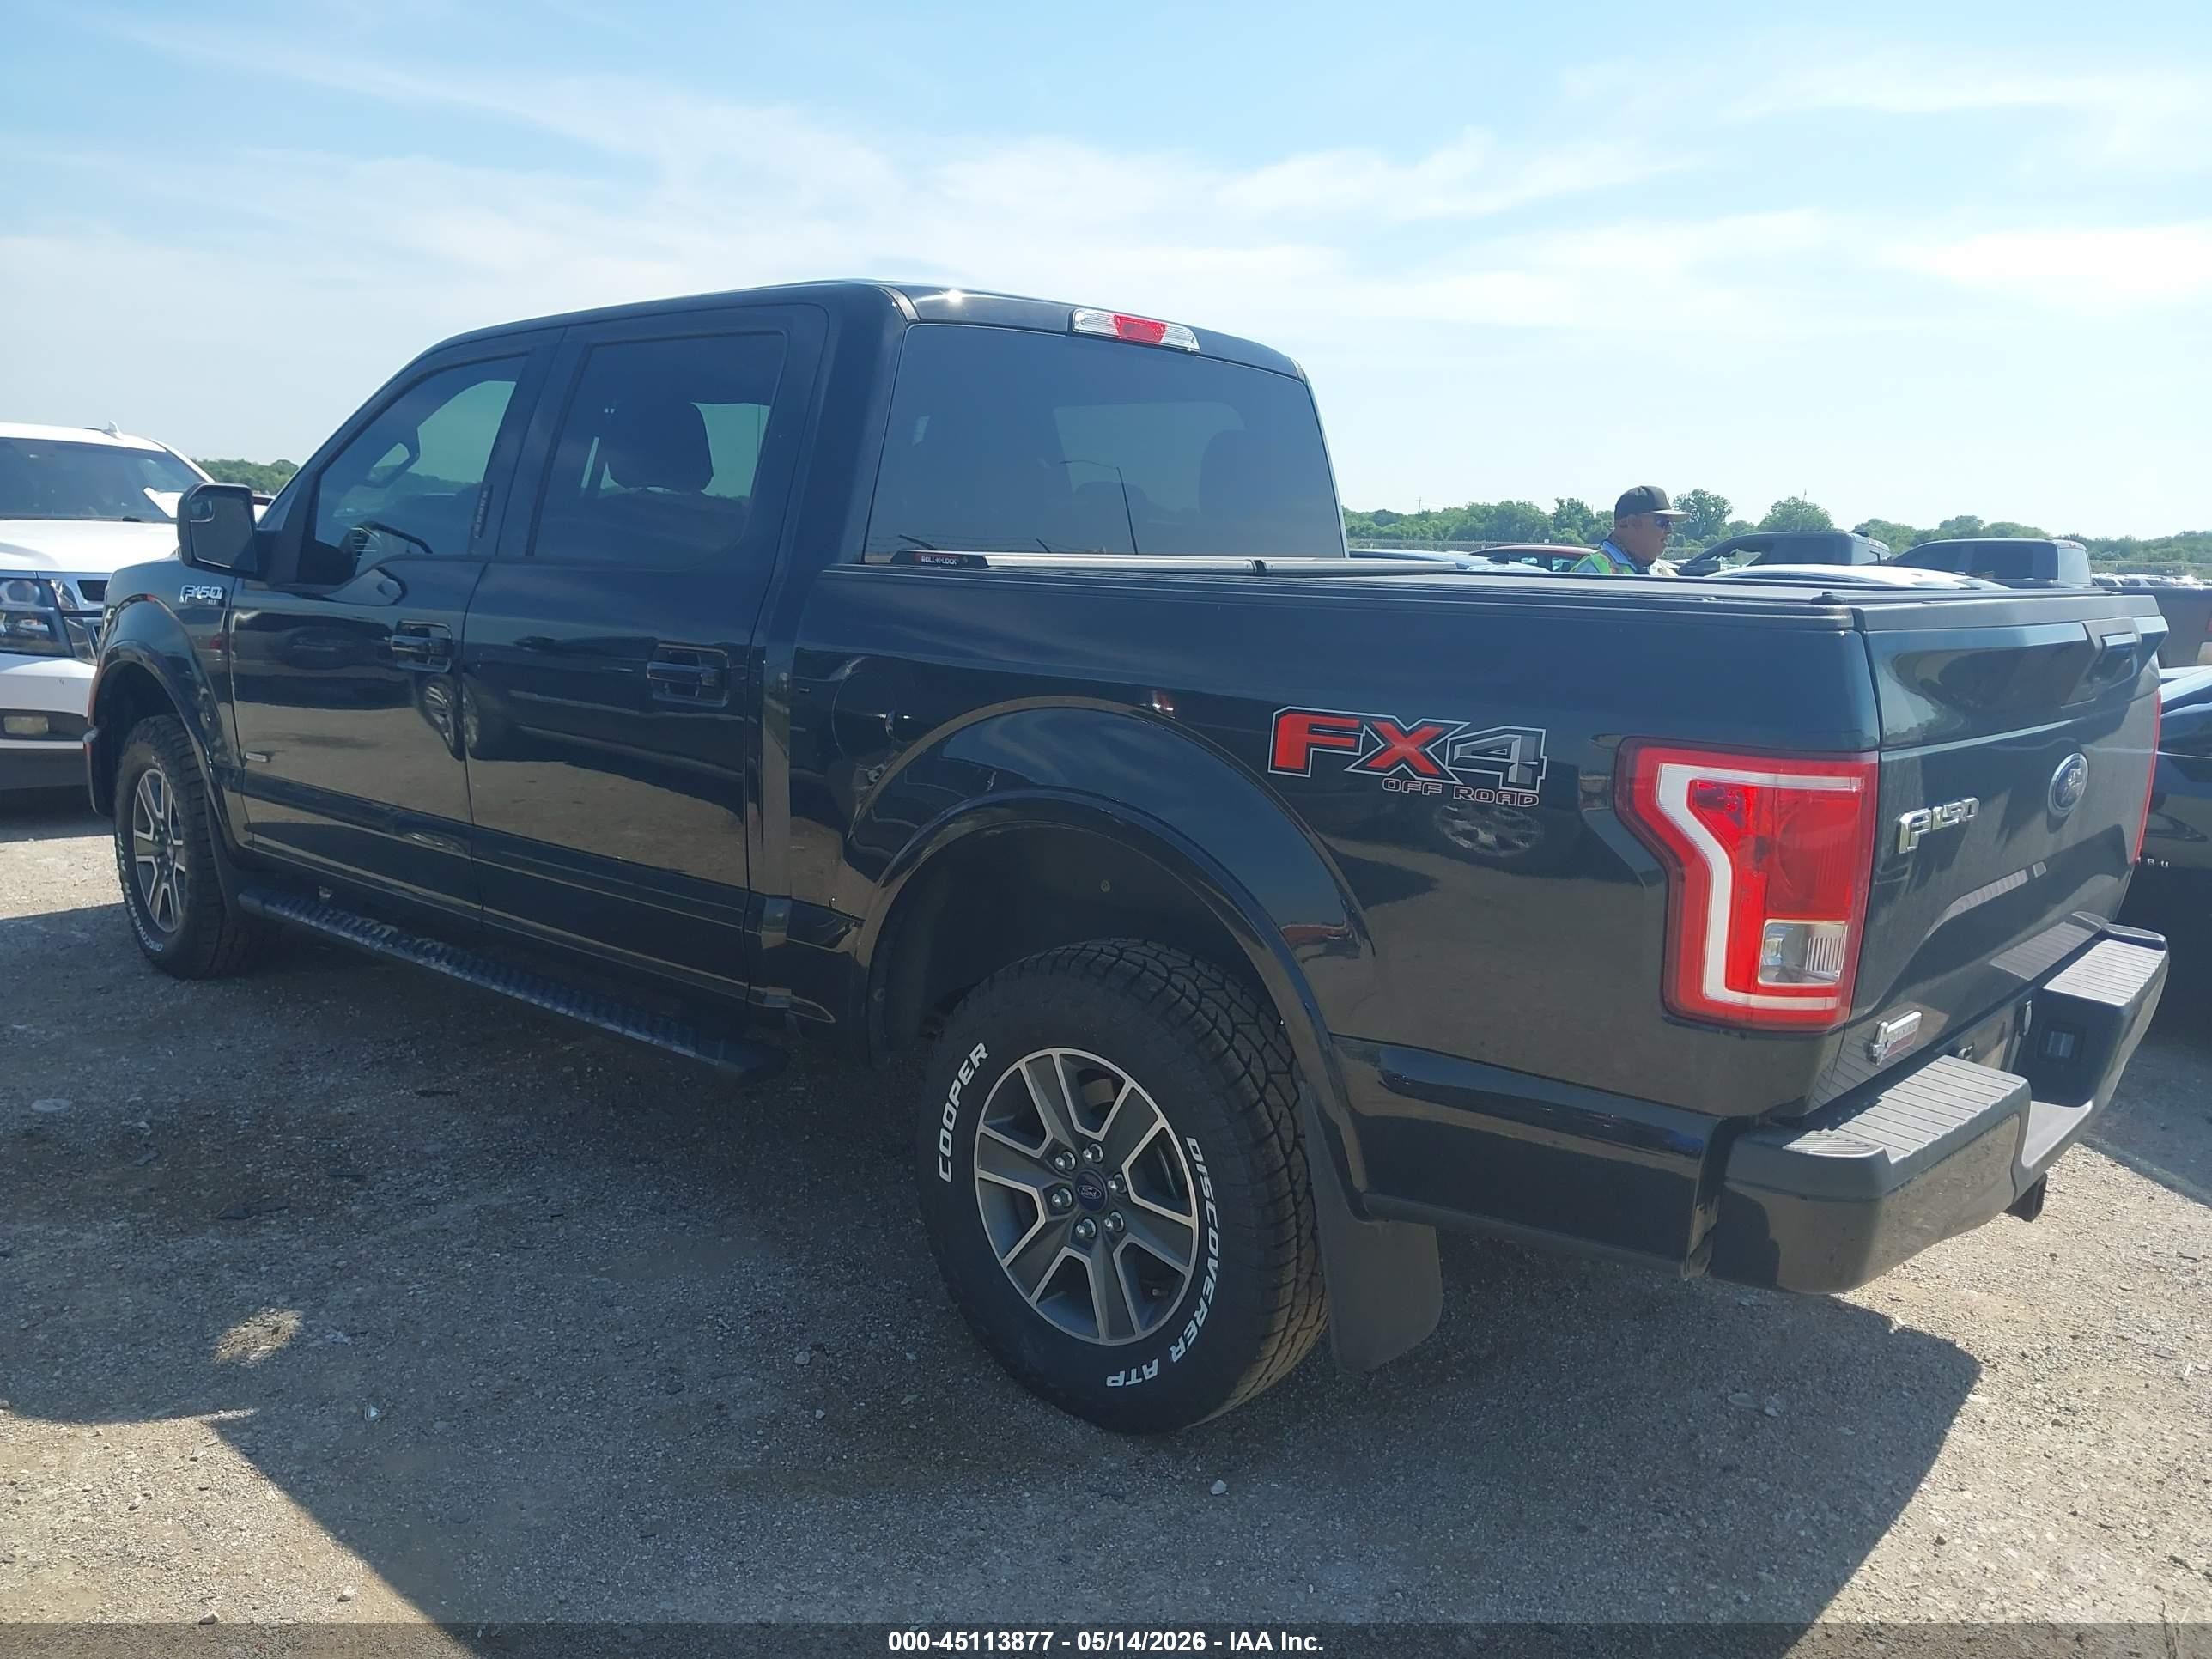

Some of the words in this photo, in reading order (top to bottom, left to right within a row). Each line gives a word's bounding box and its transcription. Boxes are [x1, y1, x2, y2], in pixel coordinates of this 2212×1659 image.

[1268, 706, 1547, 793] FX4
[1382, 777, 1443, 796] OFF
[1453, 785, 1540, 807] ROAD
[939, 1042, 989, 1182] COOPER
[1169, 1136, 1220, 1363] DISCOVERER
[1106, 1358, 1159, 1387] ATP
